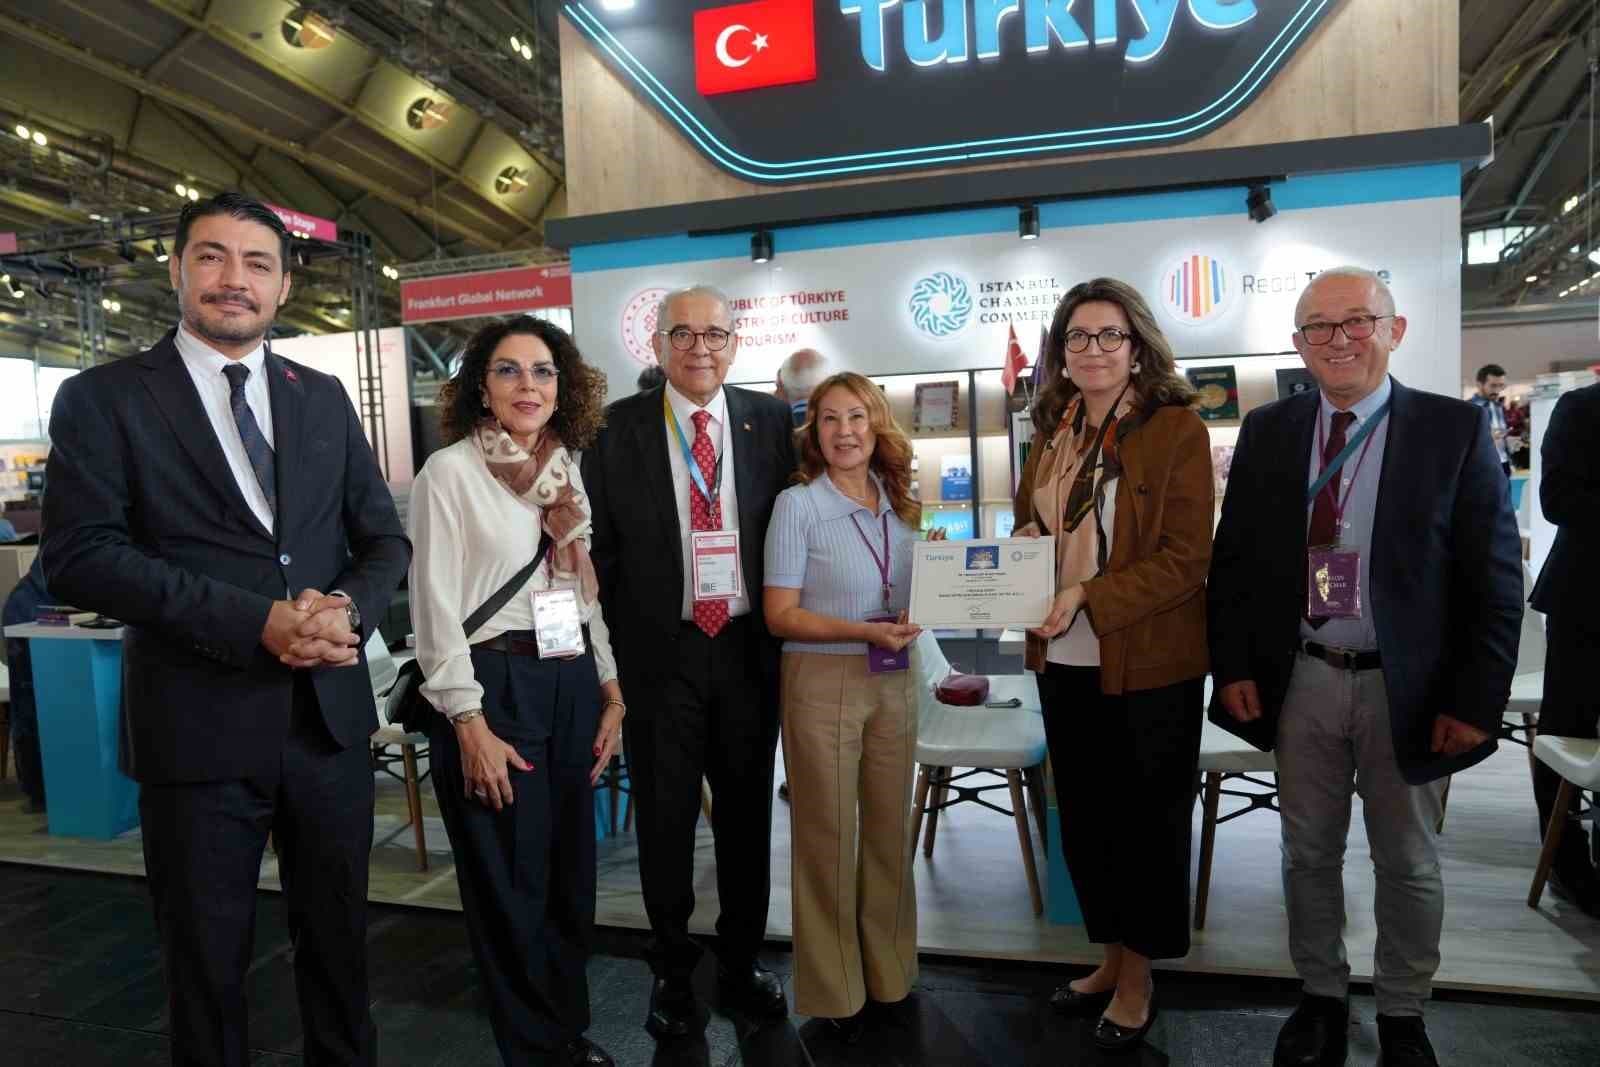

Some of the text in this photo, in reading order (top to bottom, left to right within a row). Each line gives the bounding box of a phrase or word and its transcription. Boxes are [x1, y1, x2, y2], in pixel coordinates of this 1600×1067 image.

[408, 286, 543, 310] Frankfurt Global Network
[979, 293, 1061, 308] CHAMBER
[792, 309, 849, 324] CULTURE
[979, 310, 1056, 324] COMMER
